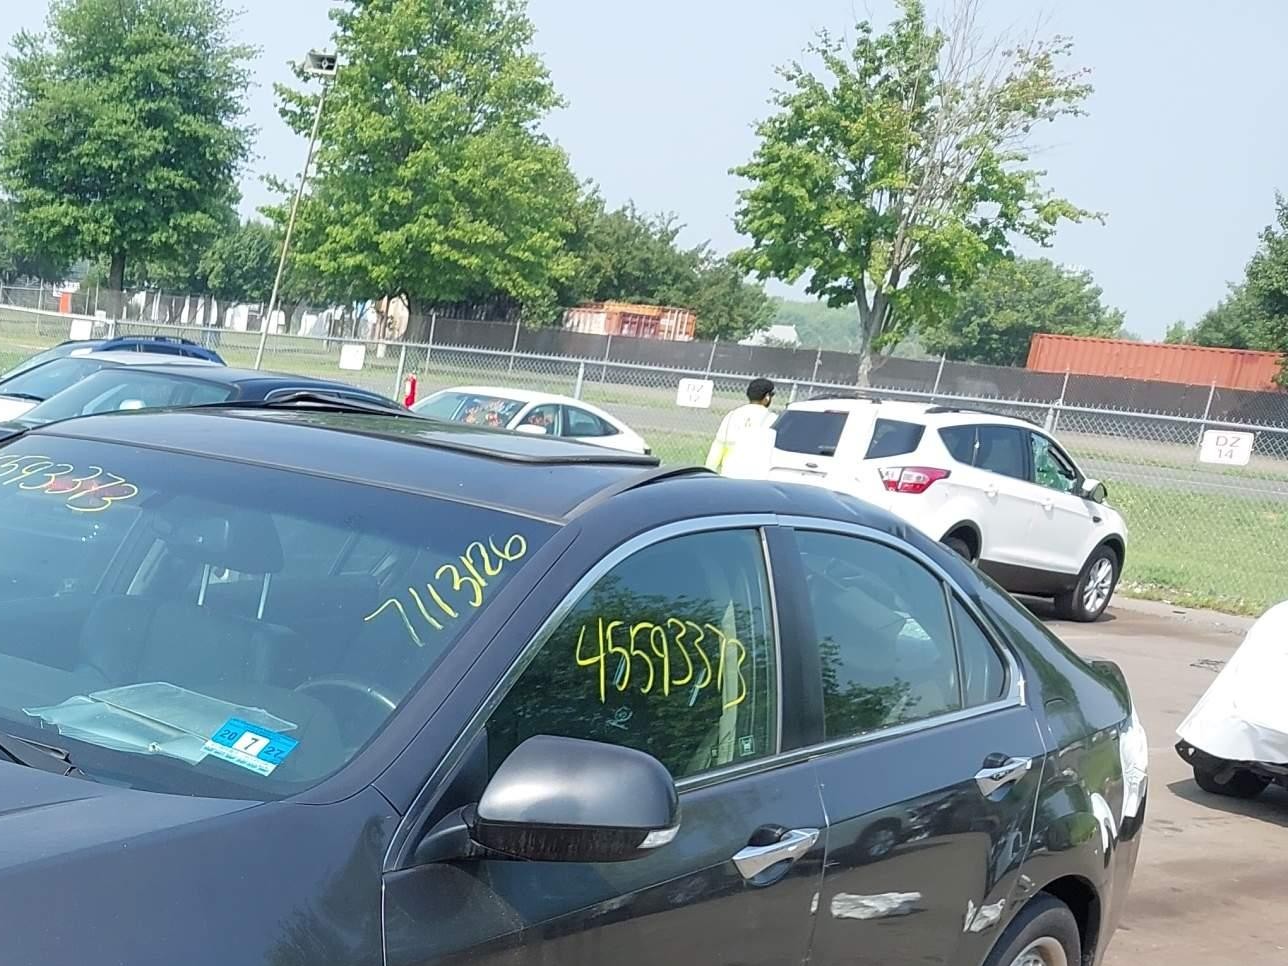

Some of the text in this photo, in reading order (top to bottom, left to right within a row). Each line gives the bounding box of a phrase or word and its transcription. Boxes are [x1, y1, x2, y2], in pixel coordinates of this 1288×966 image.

[1215, 435, 1241, 448] DZ
[1217, 448, 1235, 459] 14
[575, 616, 747, 710] 45593373
[219, 728, 239, 741] 20
[243, 736, 260, 751] 7
